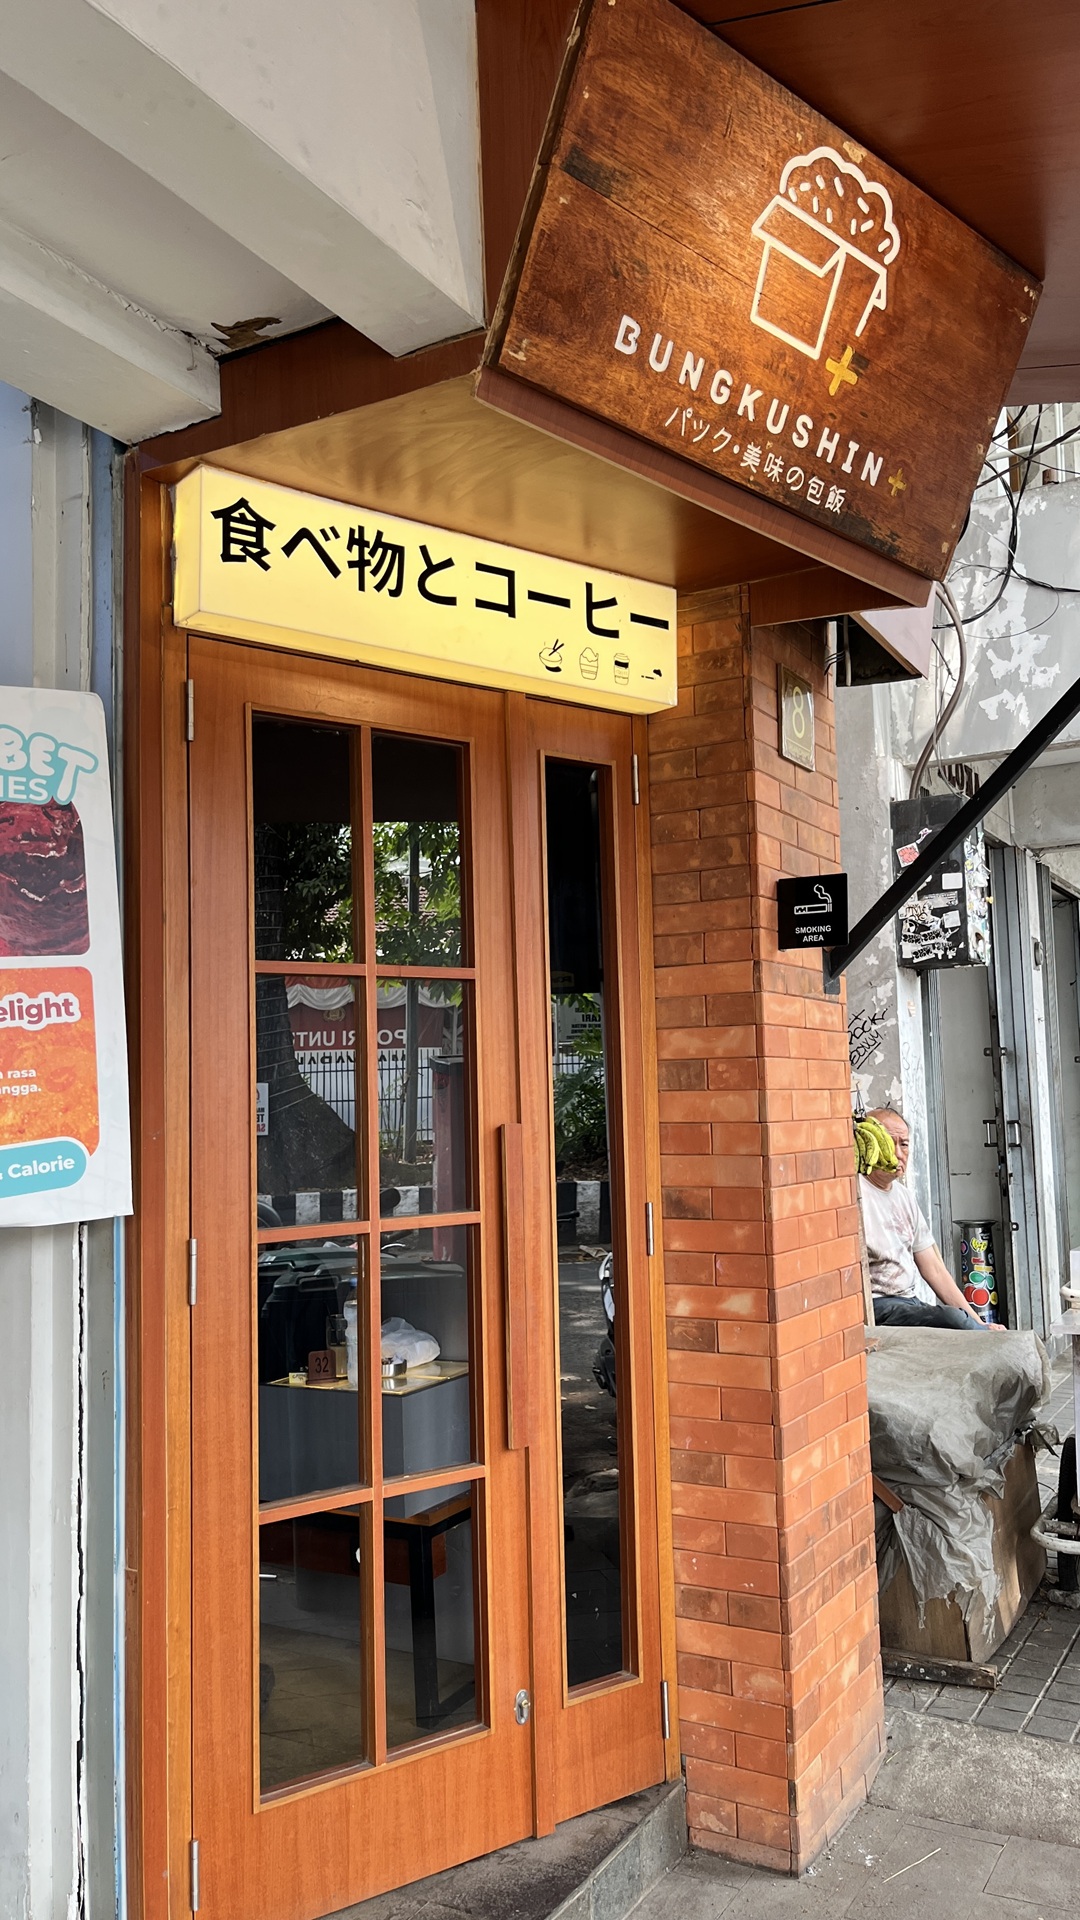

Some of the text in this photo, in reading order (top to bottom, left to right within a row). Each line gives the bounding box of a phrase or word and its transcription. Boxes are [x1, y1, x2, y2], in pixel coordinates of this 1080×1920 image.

[210, 497, 670, 640] 食べ物とコーヒー
[792, 686, 805, 738] 8
[795, 925, 831, 934] SMOKING
[7, 1069, 37, 1079] rasa
[0, 1083, 42, 1096] ngga.
[8, 1155, 75, 1178] Calorie
[315, 1356, 329, 1373] 32
